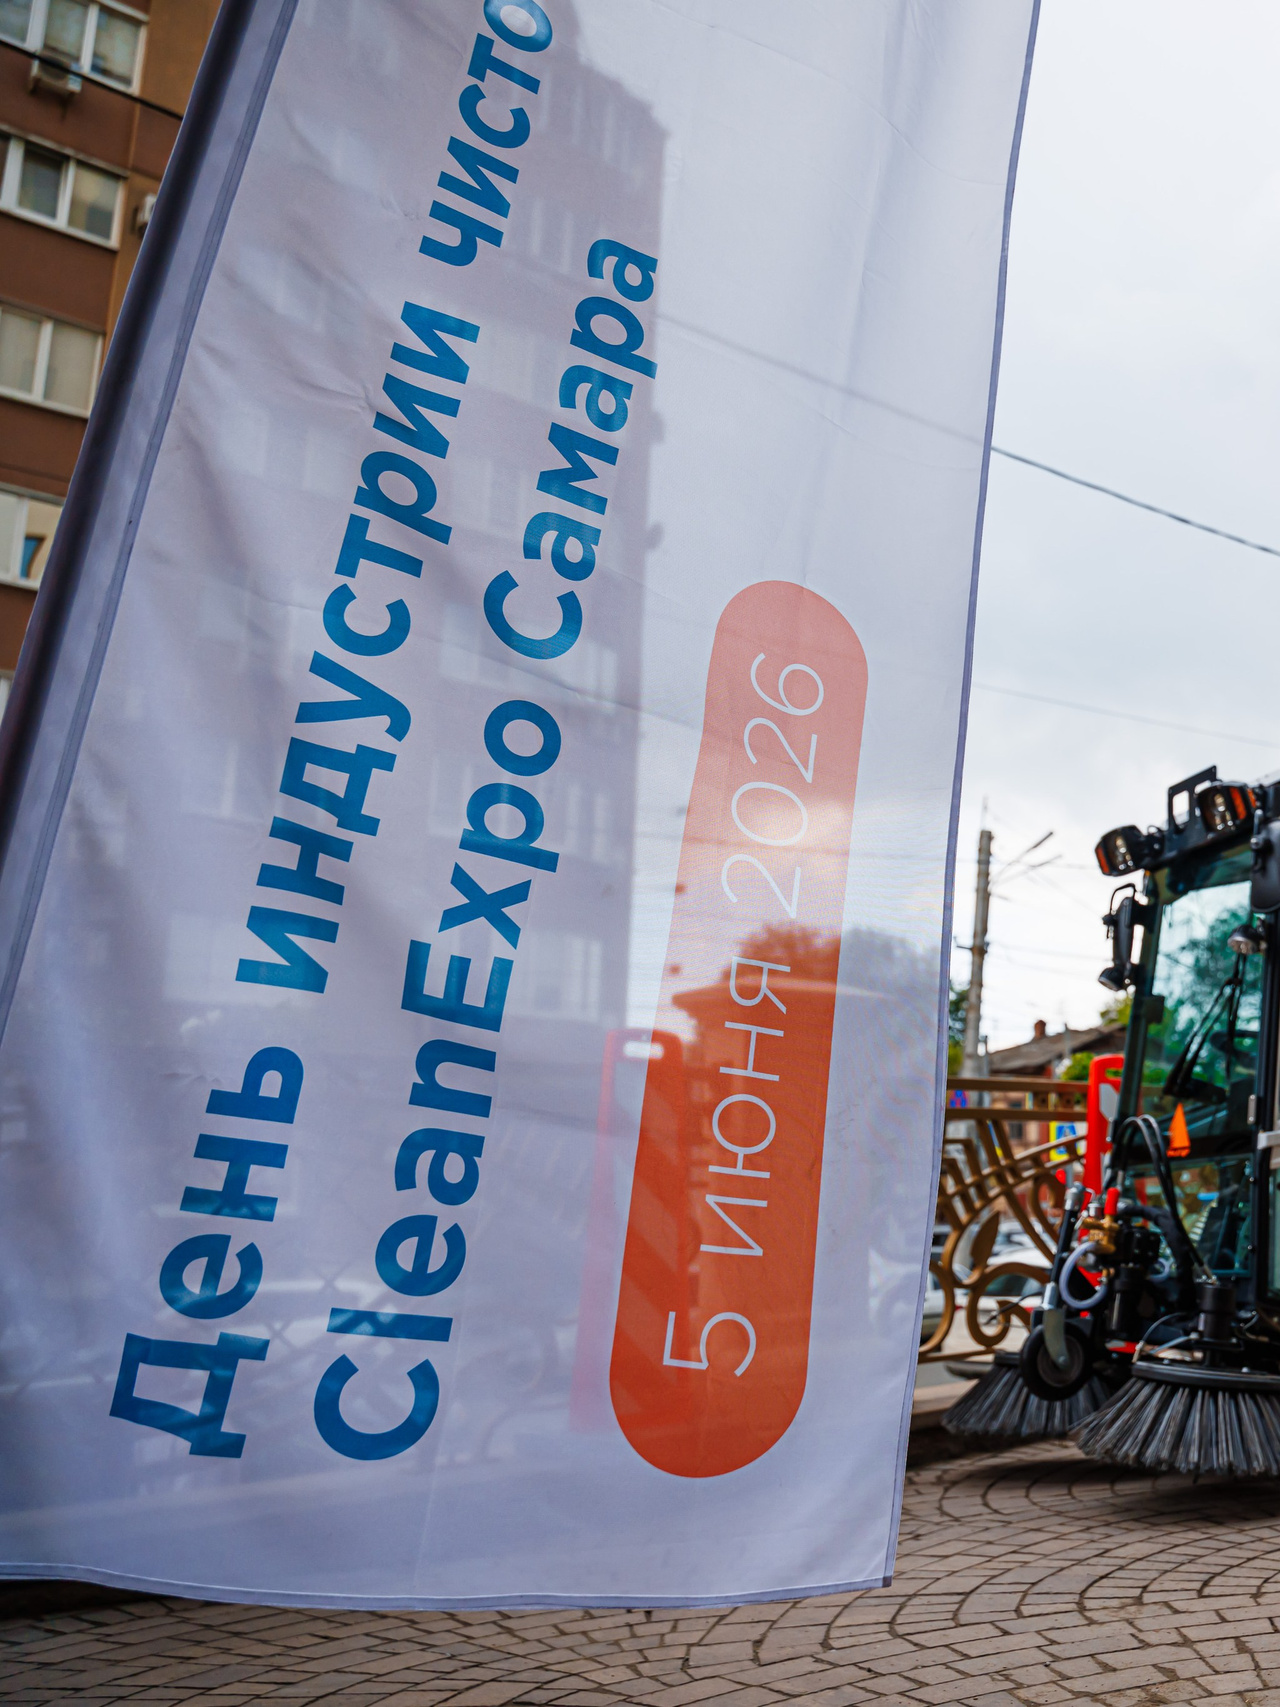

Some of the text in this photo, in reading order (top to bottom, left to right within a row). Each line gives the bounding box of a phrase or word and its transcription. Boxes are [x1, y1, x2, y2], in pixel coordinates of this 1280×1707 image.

[109, 0, 553, 1459] День индустрии чисто
[313, 238, 658, 1461] CleanExpo Самара
[663, 1311, 756, 1377] 5
[721, 652, 824, 918] 2026
